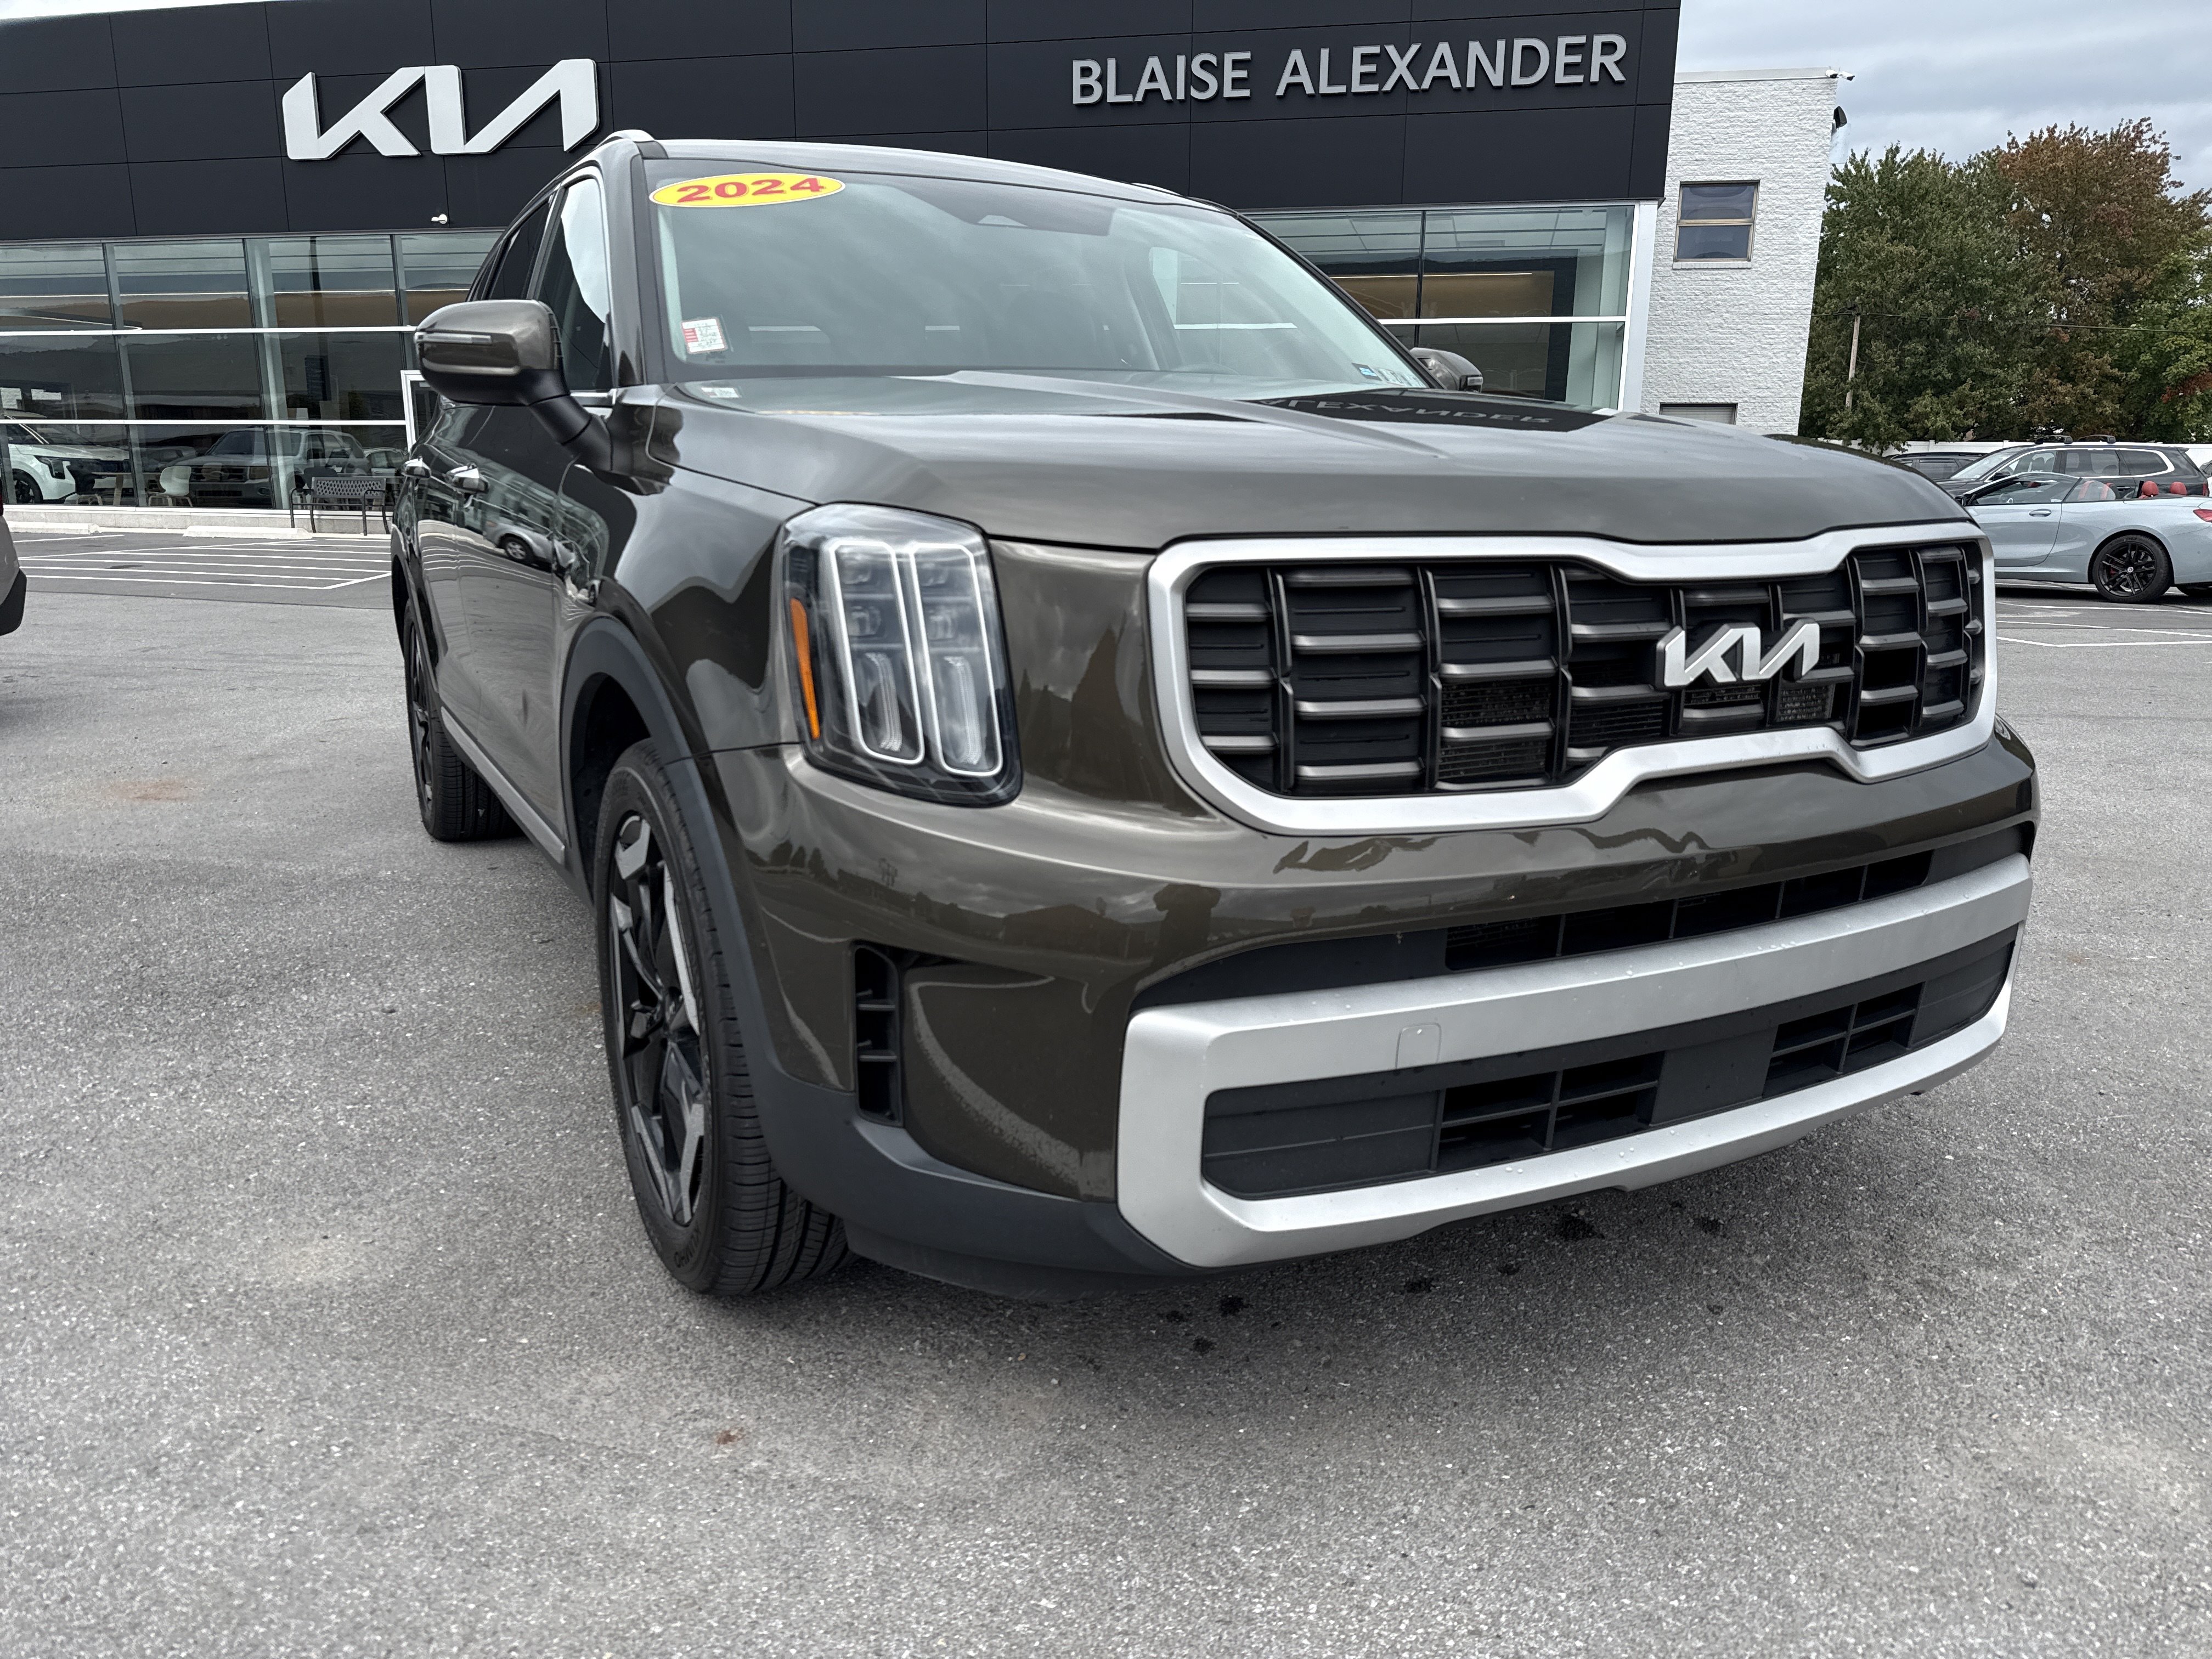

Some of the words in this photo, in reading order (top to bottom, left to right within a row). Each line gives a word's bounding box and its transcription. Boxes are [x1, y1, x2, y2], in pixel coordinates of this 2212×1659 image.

[1072, 50, 1252, 105] BLAISE
[1274, 33, 1627, 97] ALEXANDER
[282, 58, 599, 160] KIA
[677, 178, 825, 203] 2024
[1657, 619, 1820, 688] KIA
